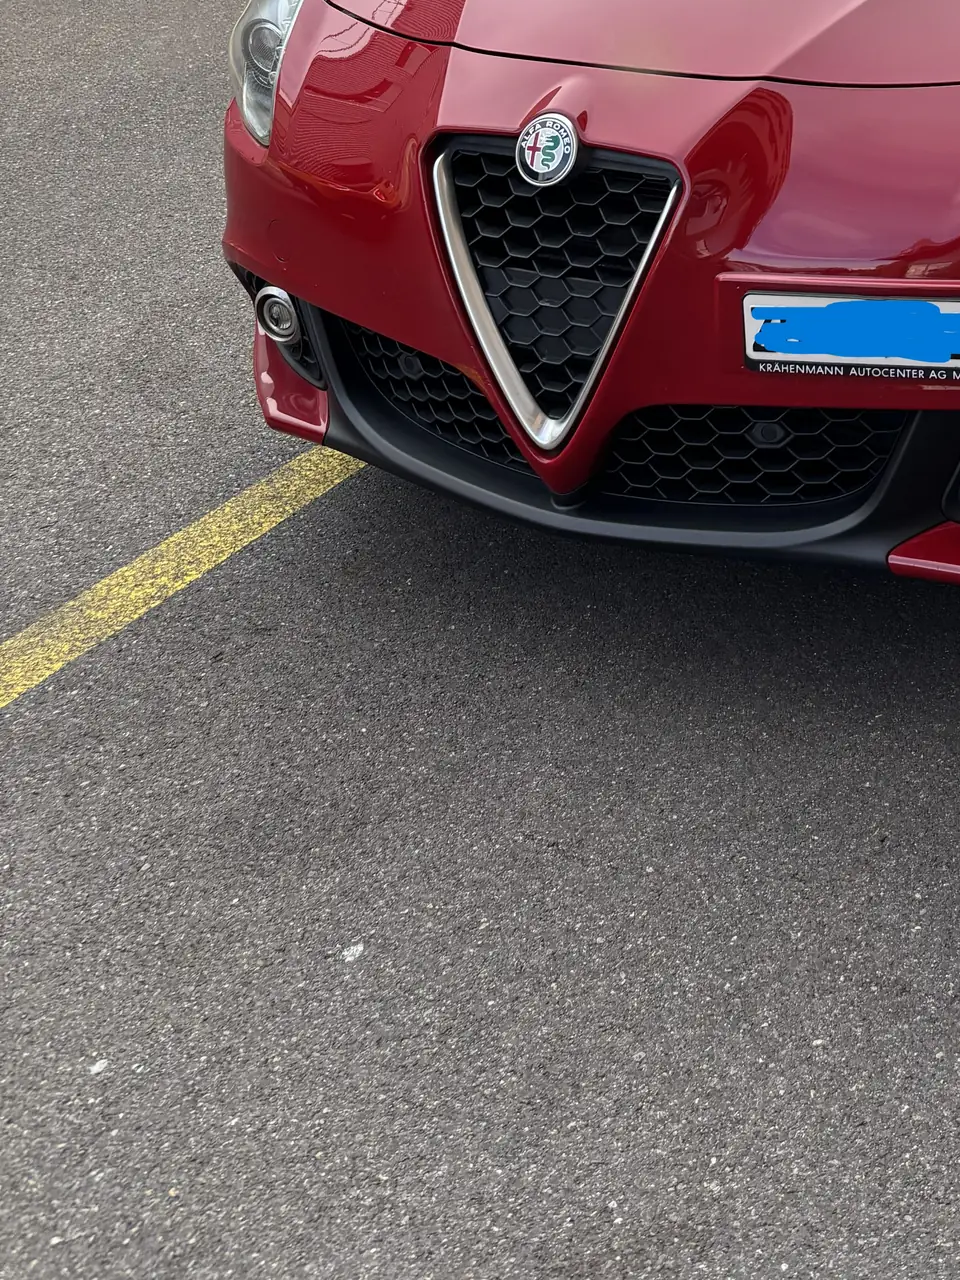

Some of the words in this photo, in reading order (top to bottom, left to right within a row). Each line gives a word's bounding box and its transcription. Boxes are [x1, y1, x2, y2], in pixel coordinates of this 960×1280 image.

[521, 123, 541, 148] ALFA
[546, 121, 570, 154] ROMEO
[759, 362, 844, 376] KRÄHENMANN
[849, 367, 925, 379] AUTOCENTER
[929, 370, 947, 380] AG
